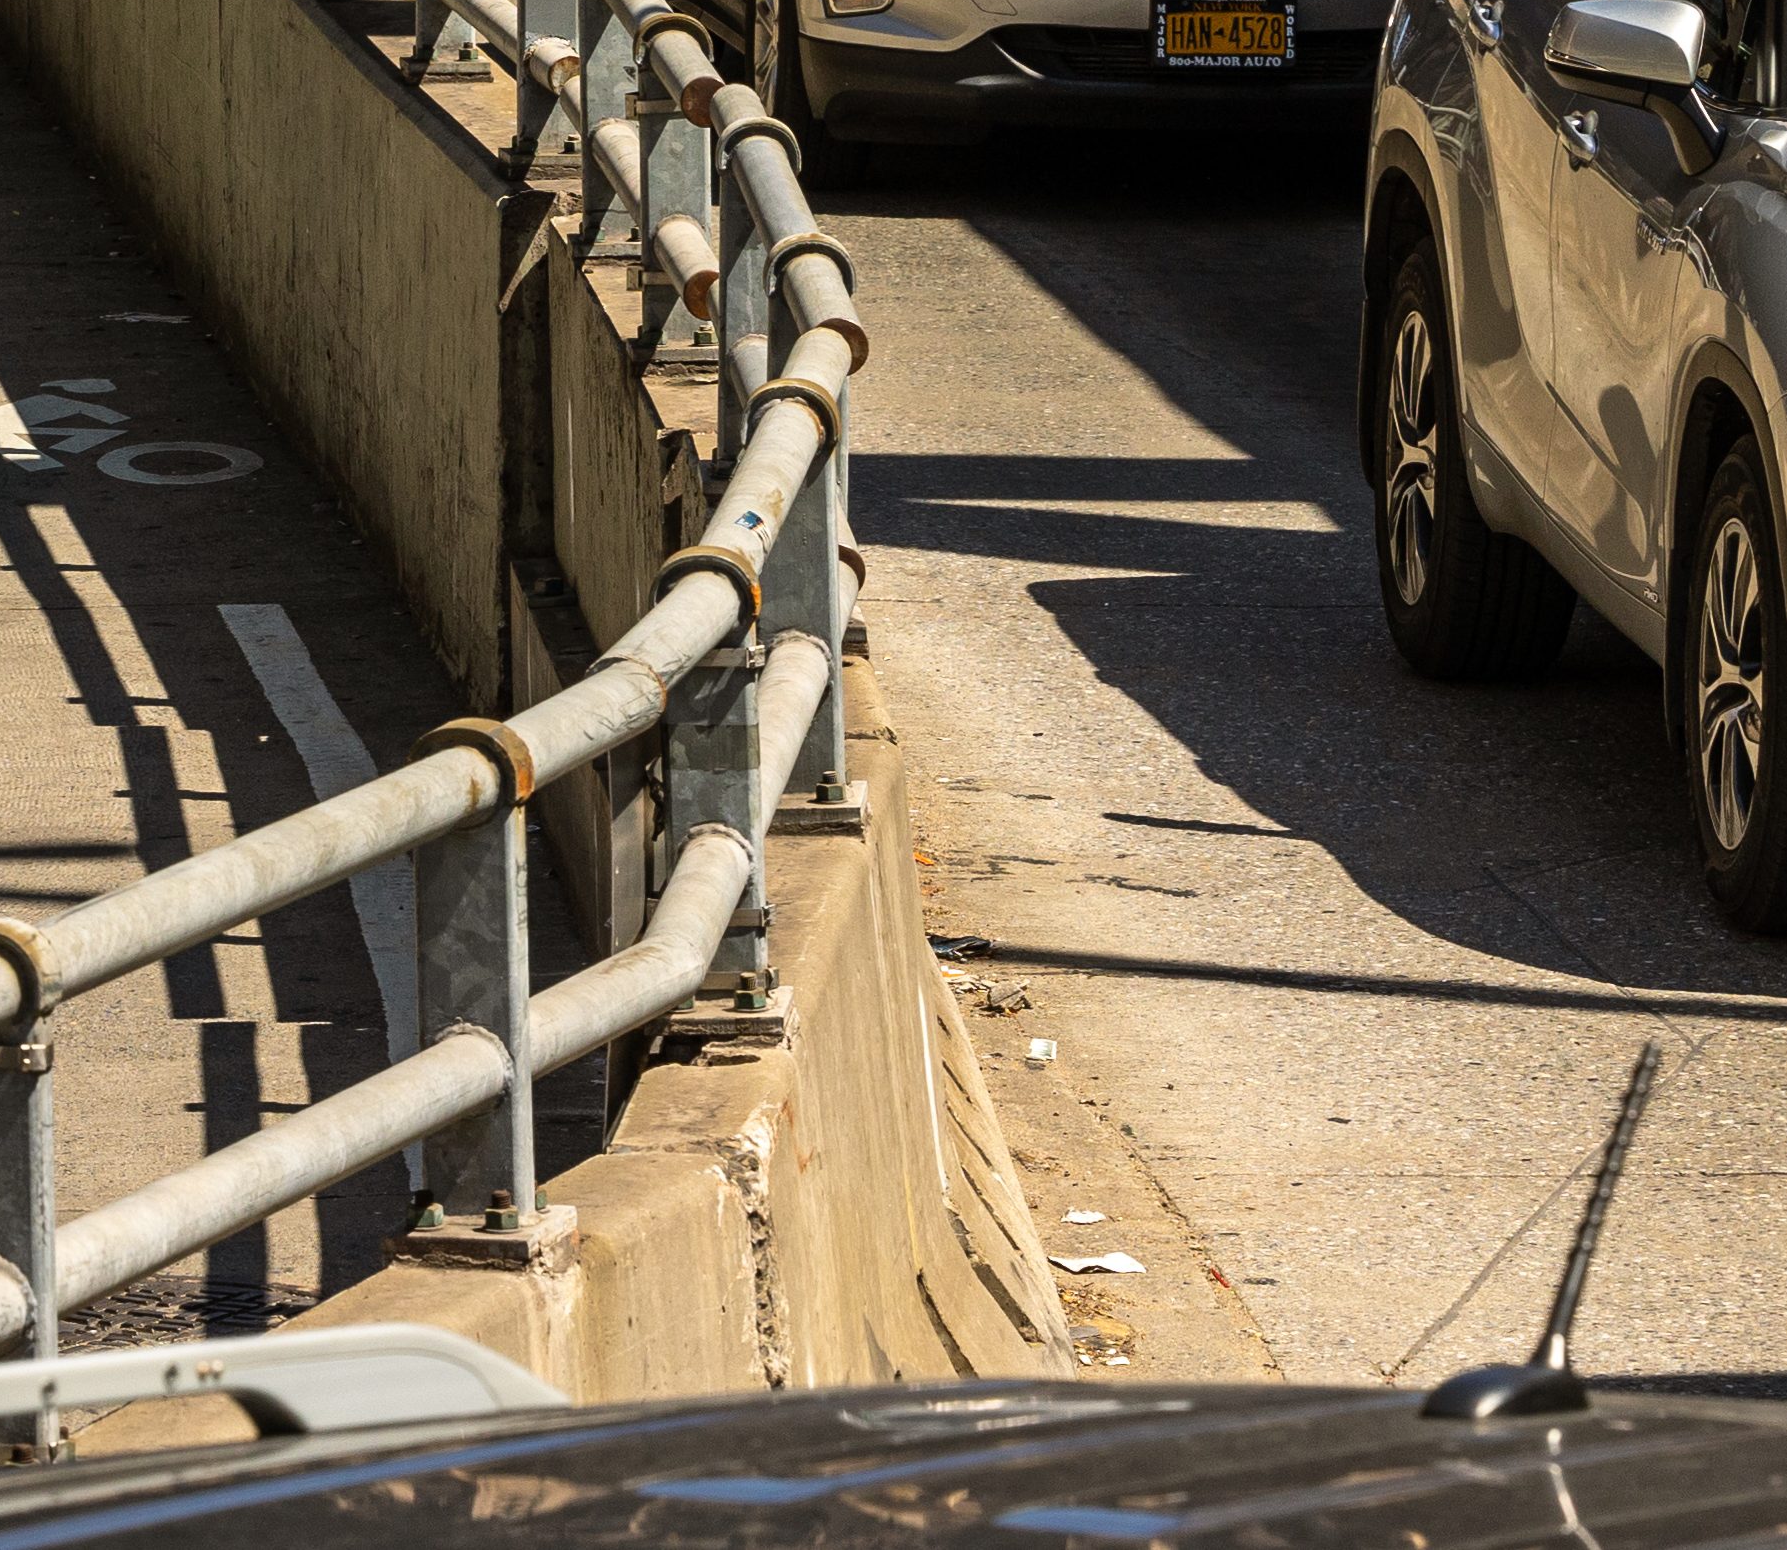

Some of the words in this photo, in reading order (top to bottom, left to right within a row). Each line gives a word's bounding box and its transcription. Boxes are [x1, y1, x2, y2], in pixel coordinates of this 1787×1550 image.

[1157, 4, 1166, 58] MAJOR
[1194, 3, 1223, 11] NEW
[1229, 3, 1262, 11] YORK
[1285, 4, 1295, 59] WORLD
